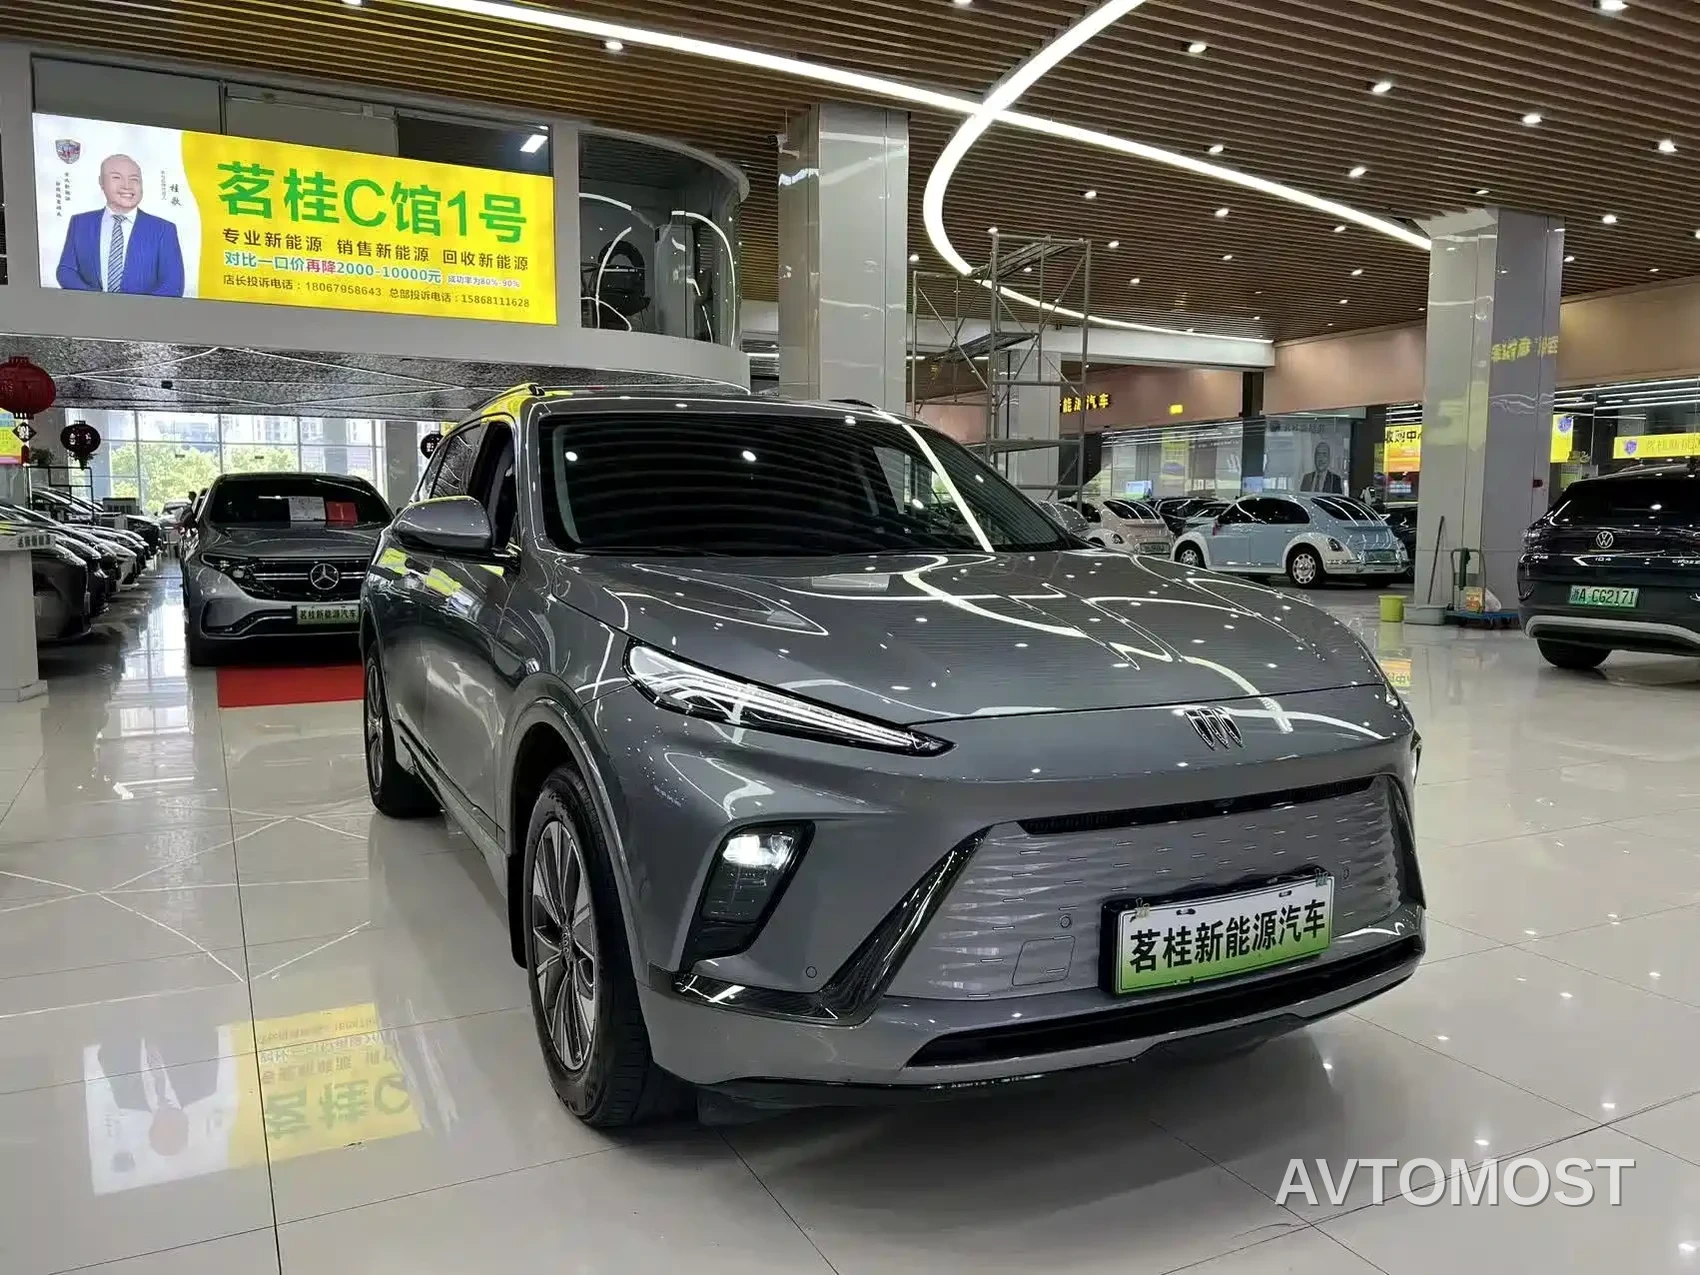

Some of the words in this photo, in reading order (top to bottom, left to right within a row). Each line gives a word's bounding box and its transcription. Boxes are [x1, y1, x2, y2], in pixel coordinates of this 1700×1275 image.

[217, 161, 527, 243] 茗桂C馆1号
[222, 227, 322, 252] 专业新能源
[337, 239, 429, 262] 销售新能源
[443, 249, 528, 271] 回收新能源
[224, 251, 441, 284] 对比一口价再降2000-10000元
[1060, 393, 1109, 413] 能源汽车
[1129, 899, 1325, 974] 茗桂新能源汽车
